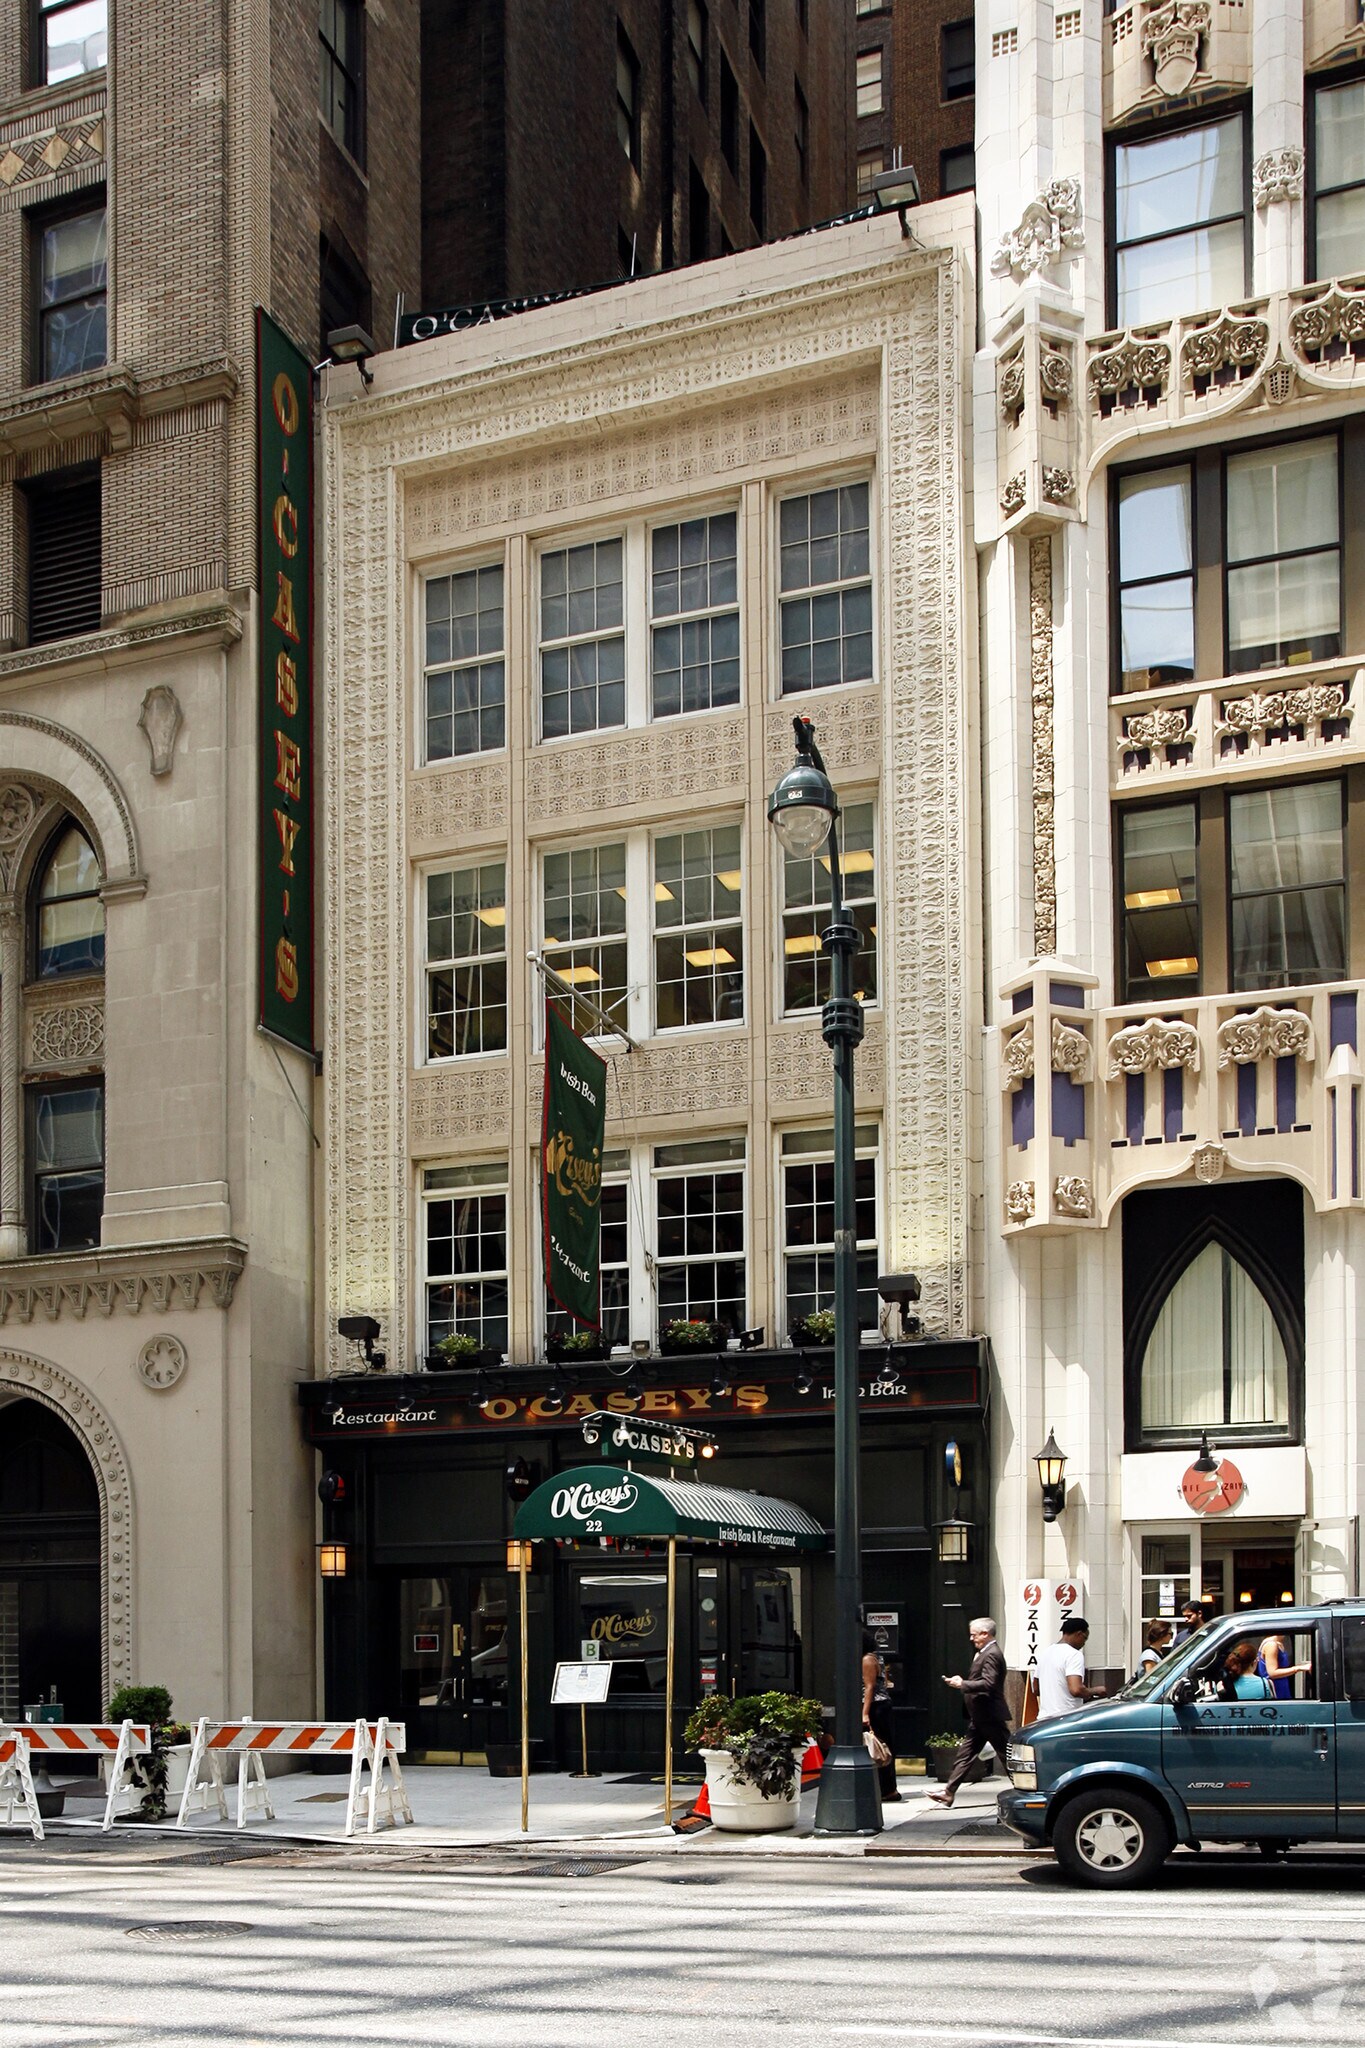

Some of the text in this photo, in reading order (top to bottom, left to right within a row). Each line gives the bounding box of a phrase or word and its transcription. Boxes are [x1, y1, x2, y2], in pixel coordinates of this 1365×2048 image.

[272, 372, 301, 1003] O'CASEY'S
[483, 1384, 769, 1420] O'CASEY'S
[869, 1382, 908, 1397] Bar
[332, 1408, 437, 1426] Restaurant
[551, 1475, 639, 1520] O'Casey's
[585, 1520, 603, 1532] 22
[719, 1526, 737, 1541] Irish
[738, 1528, 751, 1543] Bar
[757, 1530, 796, 1547] Restaurant
[590, 1608, 658, 1642] O'Casey's
[1027, 1609, 1039, 1666] ZAIYA
[586, 1643, 596, 1657] B
